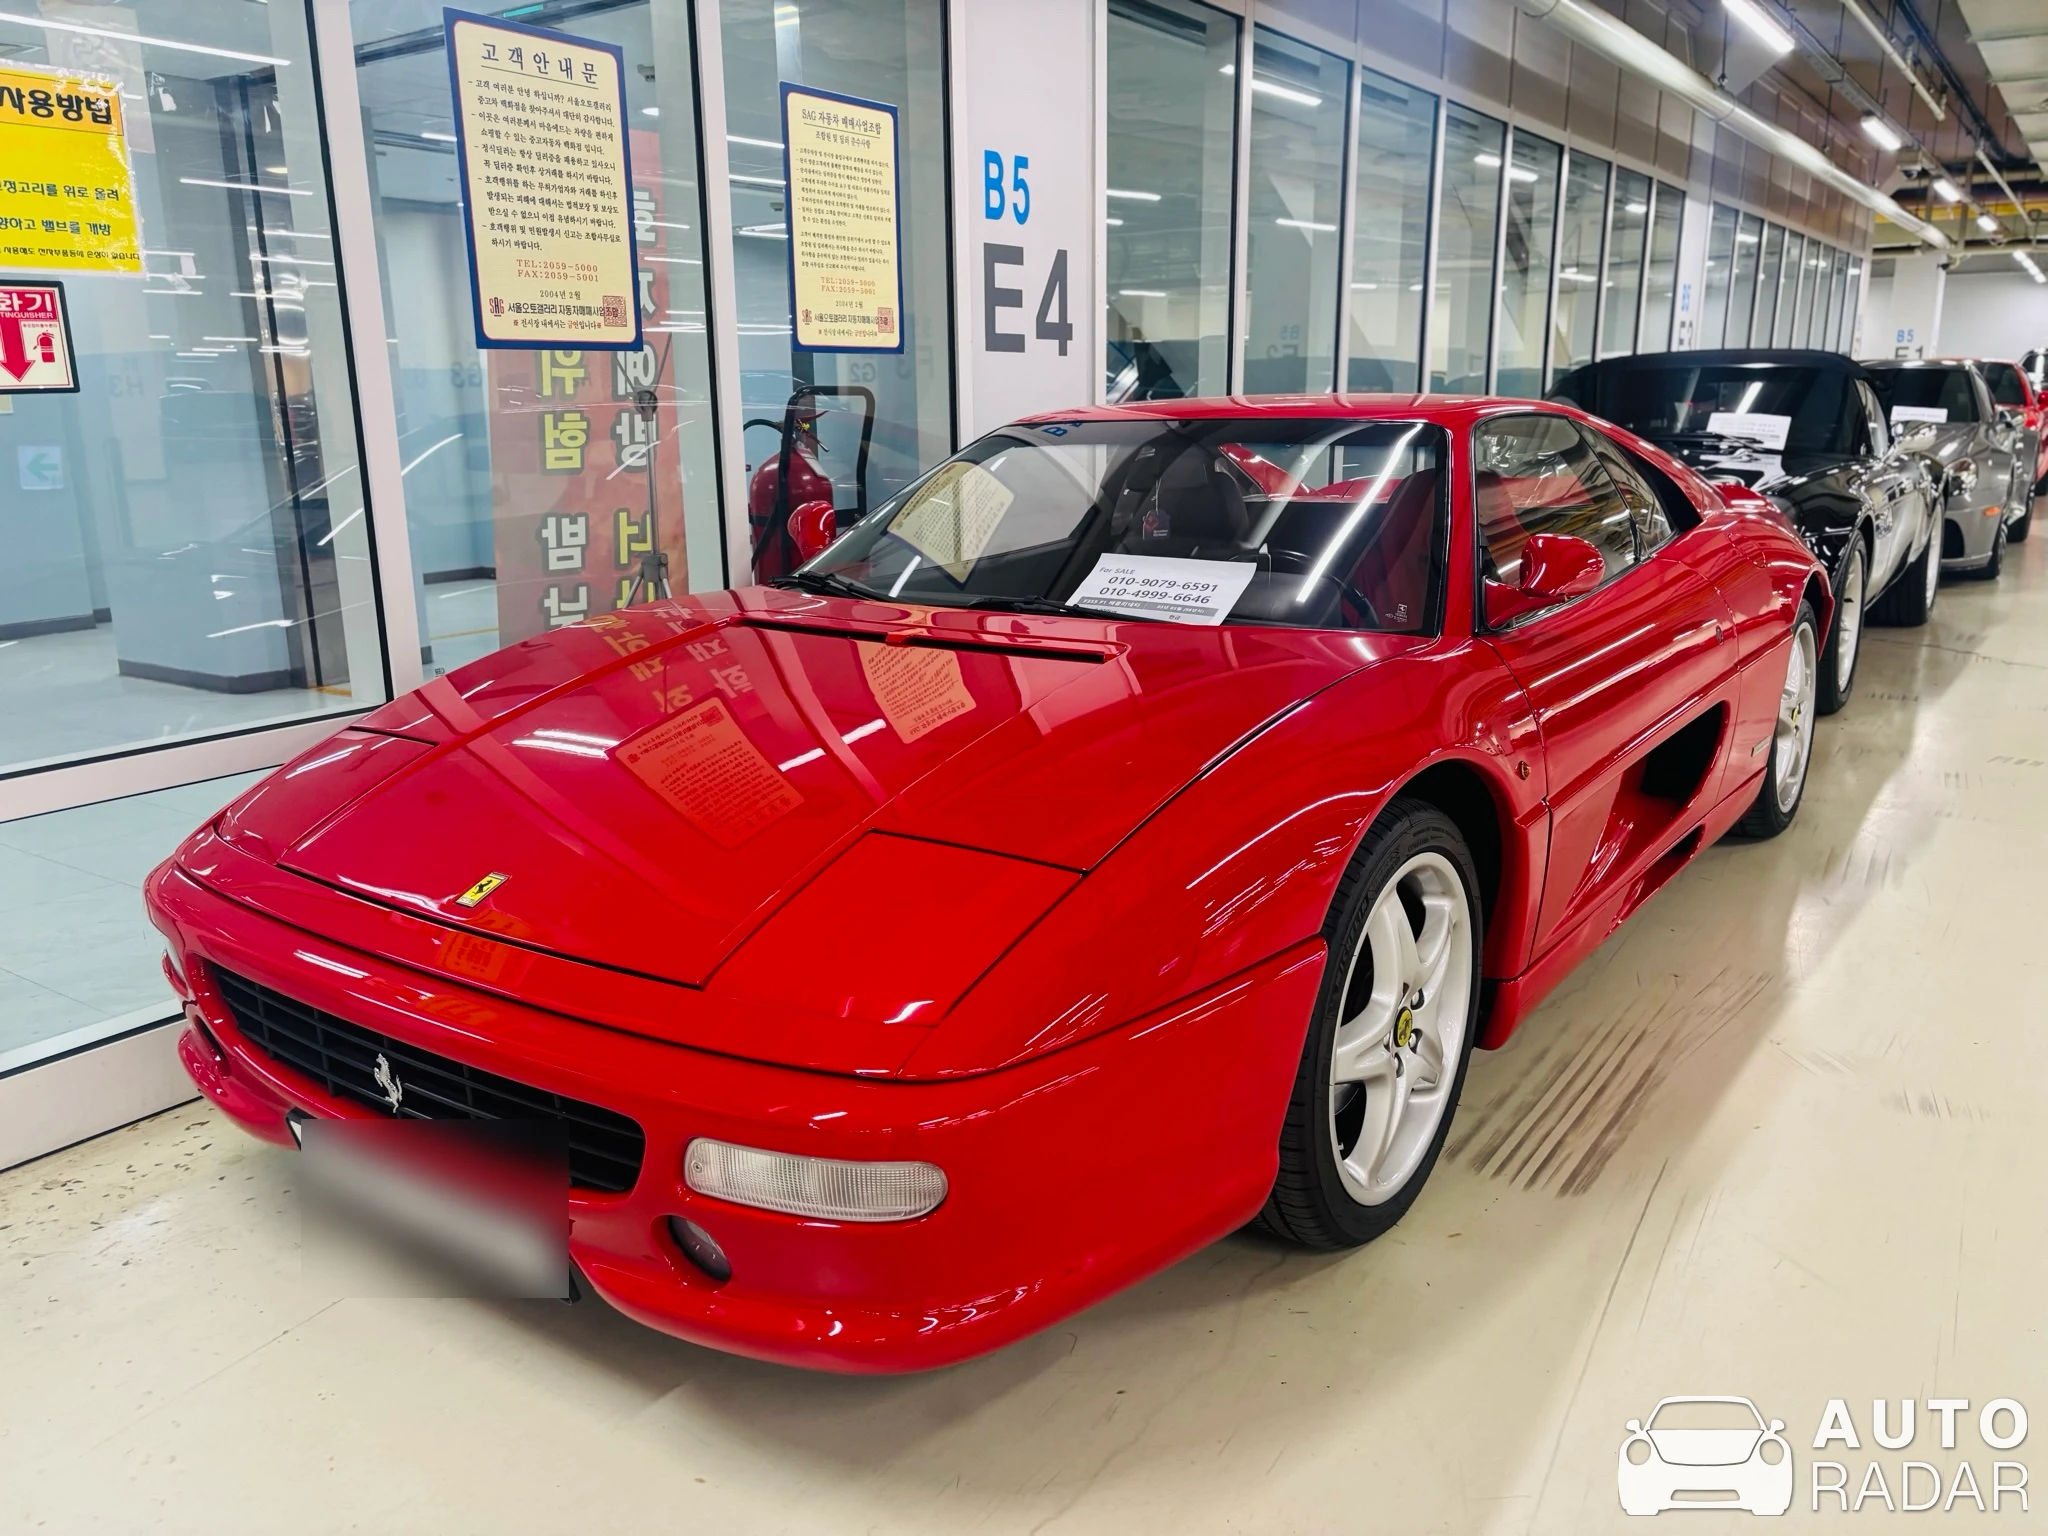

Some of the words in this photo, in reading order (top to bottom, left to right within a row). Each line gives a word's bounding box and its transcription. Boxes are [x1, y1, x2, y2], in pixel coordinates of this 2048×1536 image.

[476, 80, 489, 90] 고객
[493, 82, 514, 94] 여러분
[517, 87, 530, 97] 안녕
[534, 90, 564, 103] 하십니까?
[477, 95, 498, 107] 중고차
[500, 100, 526, 112] 백화점을
[563, 110, 581, 121] 대단히
[583, 114, 614, 127] 감사합니다.
[802, 108, 816, 120] SAG
[818, 111, 839, 126] 자동차
[504, 131, 510, 140] 수
[513, 132, 526, 143] 있는
[529, 135, 561, 148] 중고자동차
[564, 141, 581, 151] 백화점
[584, 144, 604, 155] 입니다.
[574, 128, 592, 138] 차량을
[595, 131, 613, 142] 편하게
[482, 144, 516, 156] 정식딜러는
[519, 149, 532, 159] 항상
[566, 171, 584, 181] 하시기
[586, 174, 612, 185] 바랍니다.
[0, 180, 58, 197] 정고리를
[63, 186, 89, 199] 위로
[522, 180, 535, 190] 하는
[579, 188, 597, 197] 거래를
[984, 149, 1030, 225] B5
[486, 191, 514, 202] 발생되는
[592, 204, 598, 212] 및
[601, 205, 619, 214] 보상도
[488, 206, 508, 217] 받으실
[511, 209, 518, 218] 수
[520, 210, 539, 220] 없으니
[542, 212, 554, 222] 이점
[590, 218, 615, 228] 바랍니다.
[42, 220, 81, 235] 밸브를
[87, 223, 111, 236] 개방
[519, 225, 526, 234] 및
[564, 230, 582, 239] 신고는
[491, 238, 511, 248] 하시기
[514, 240, 542, 250] 바랍니다.
[516, 259, 597, 272] TEL:2059-5000
[518, 269, 598, 282] FAX:2059-5001
[540, 290, 566, 299] 2004년
[569, 291, 580, 300] 2월
[984, 242, 1073, 357] E4
[1896, 329, 1914, 343] B5
[1108, 576, 1219, 593] 010-9079-6591
[1099, 587, 1212, 605] 010-4999-6646
